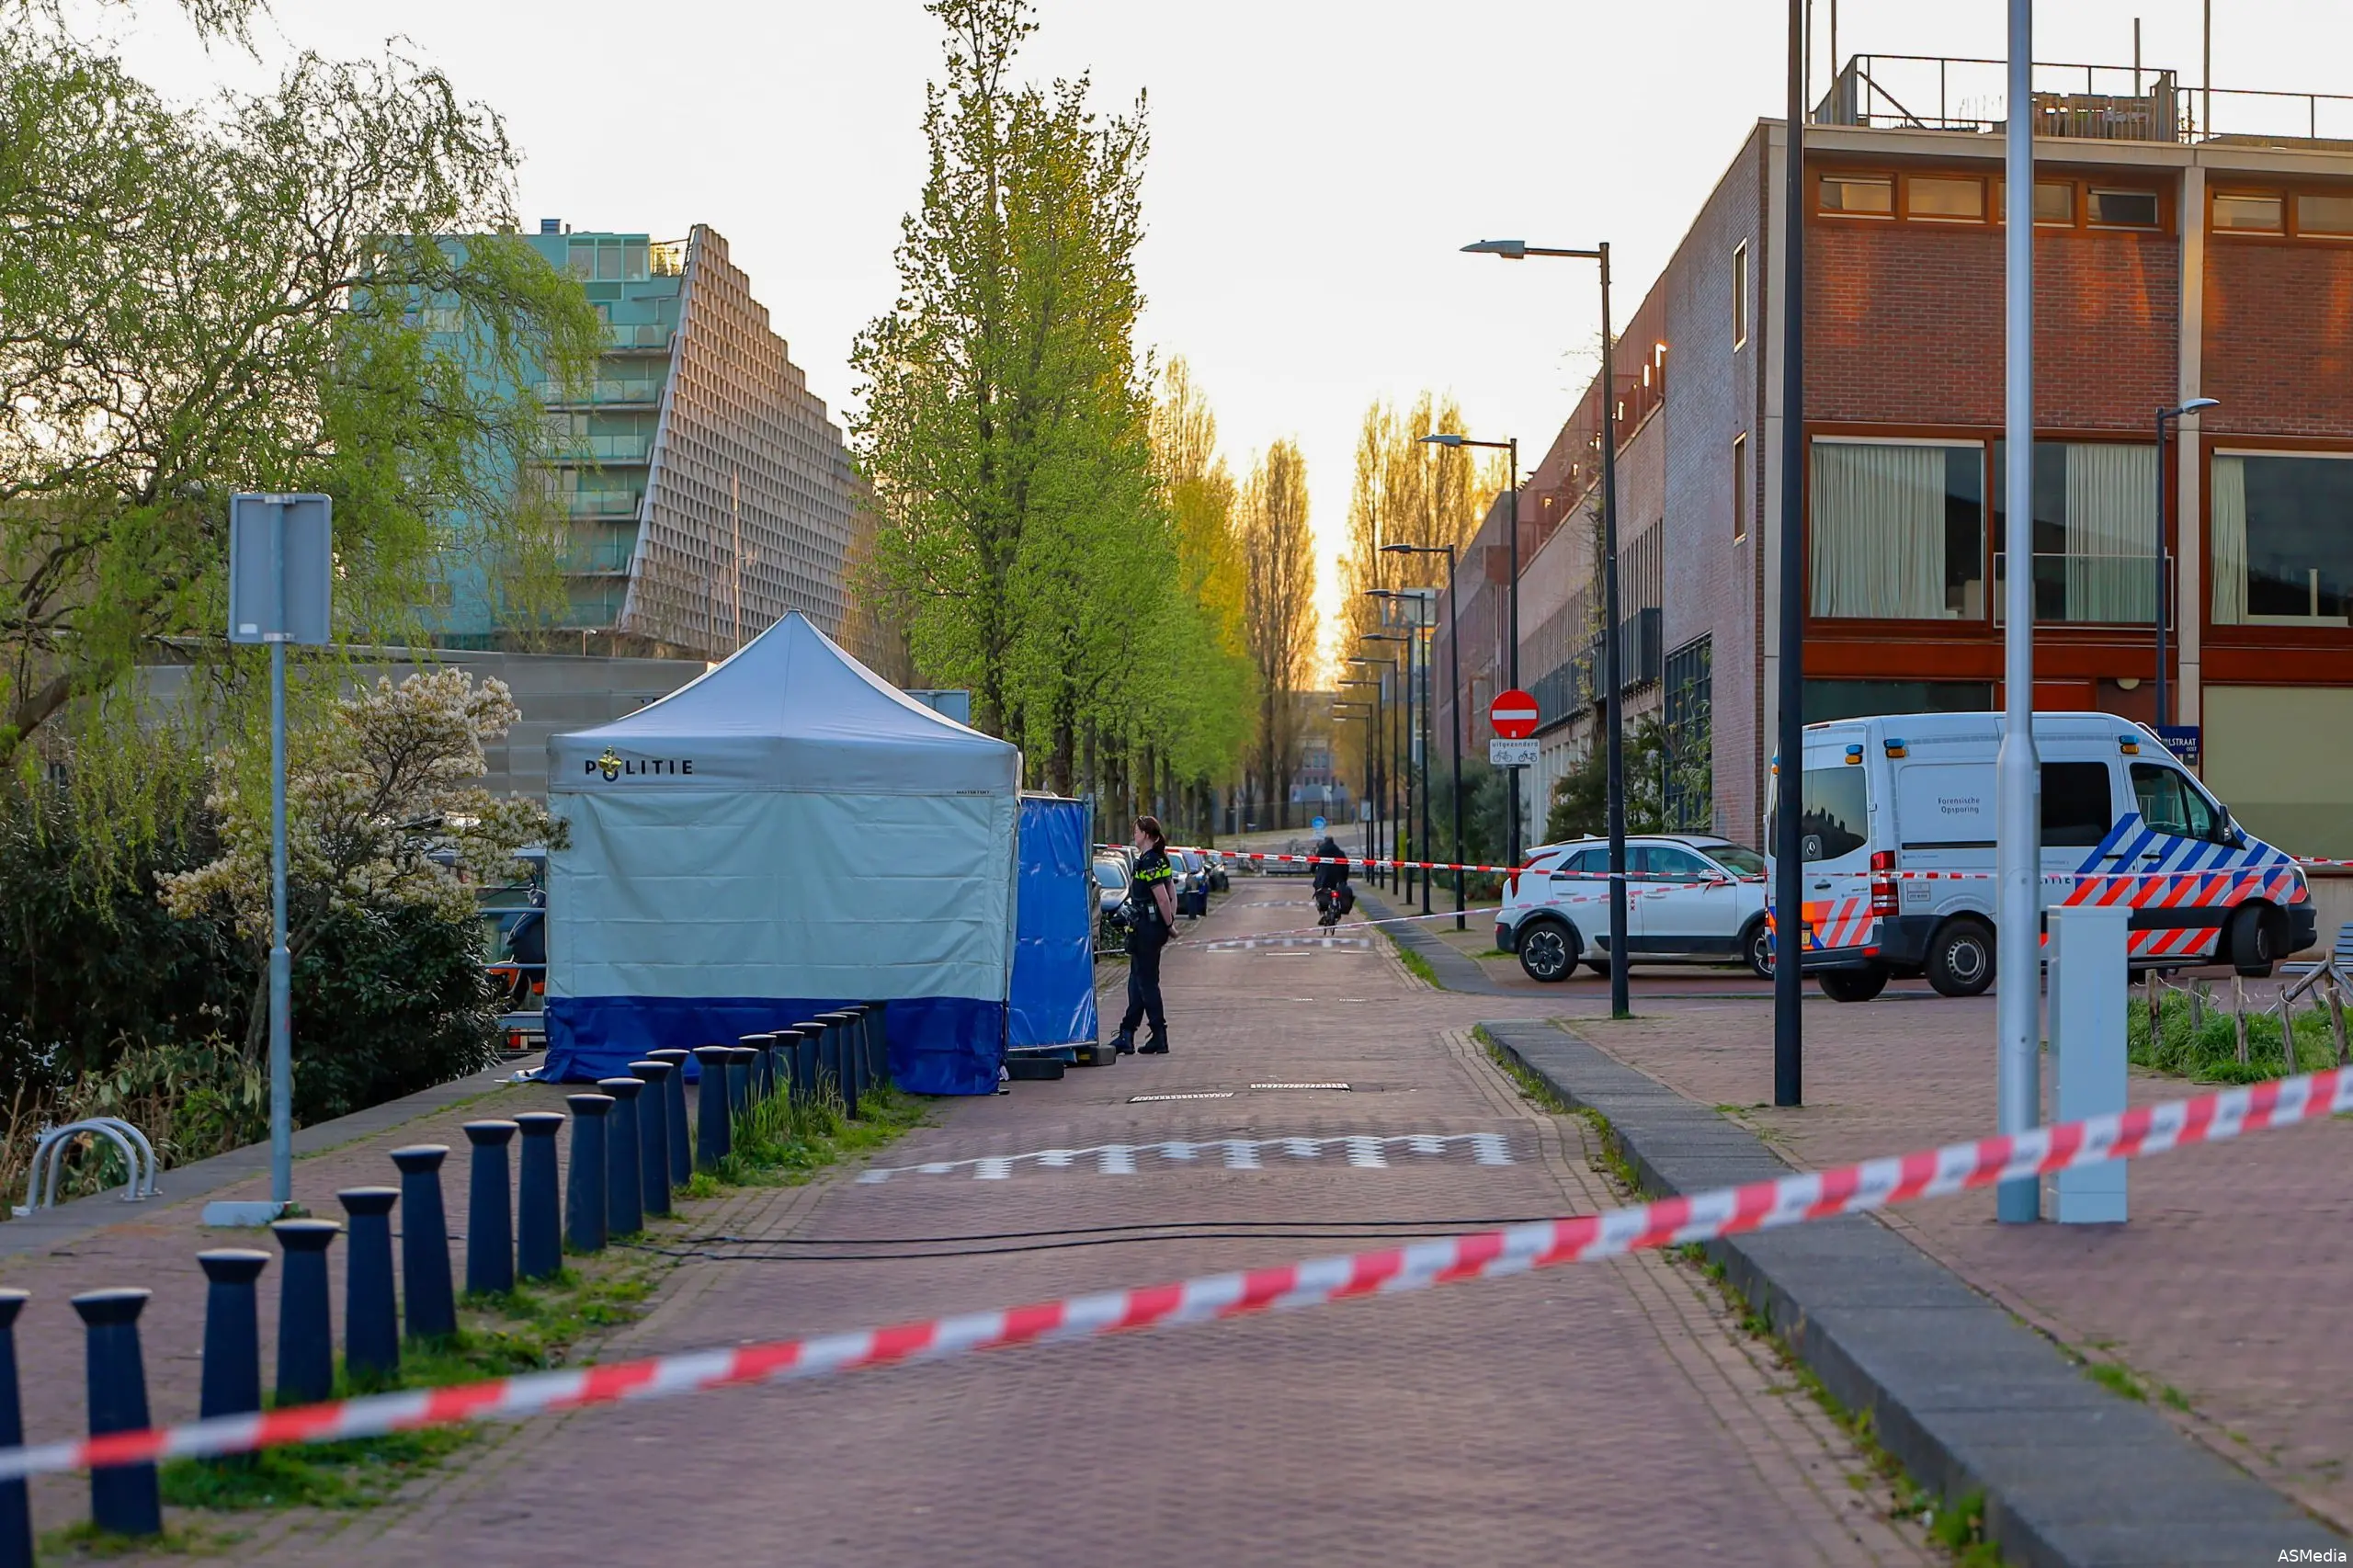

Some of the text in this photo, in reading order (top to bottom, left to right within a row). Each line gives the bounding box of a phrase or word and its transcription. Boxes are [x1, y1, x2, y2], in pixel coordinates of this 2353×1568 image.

[2168, 738, 2197, 746] LSTRAAT
[585, 759, 693, 782] POLITIE
[1941, 806, 1980, 814] Opsporing
